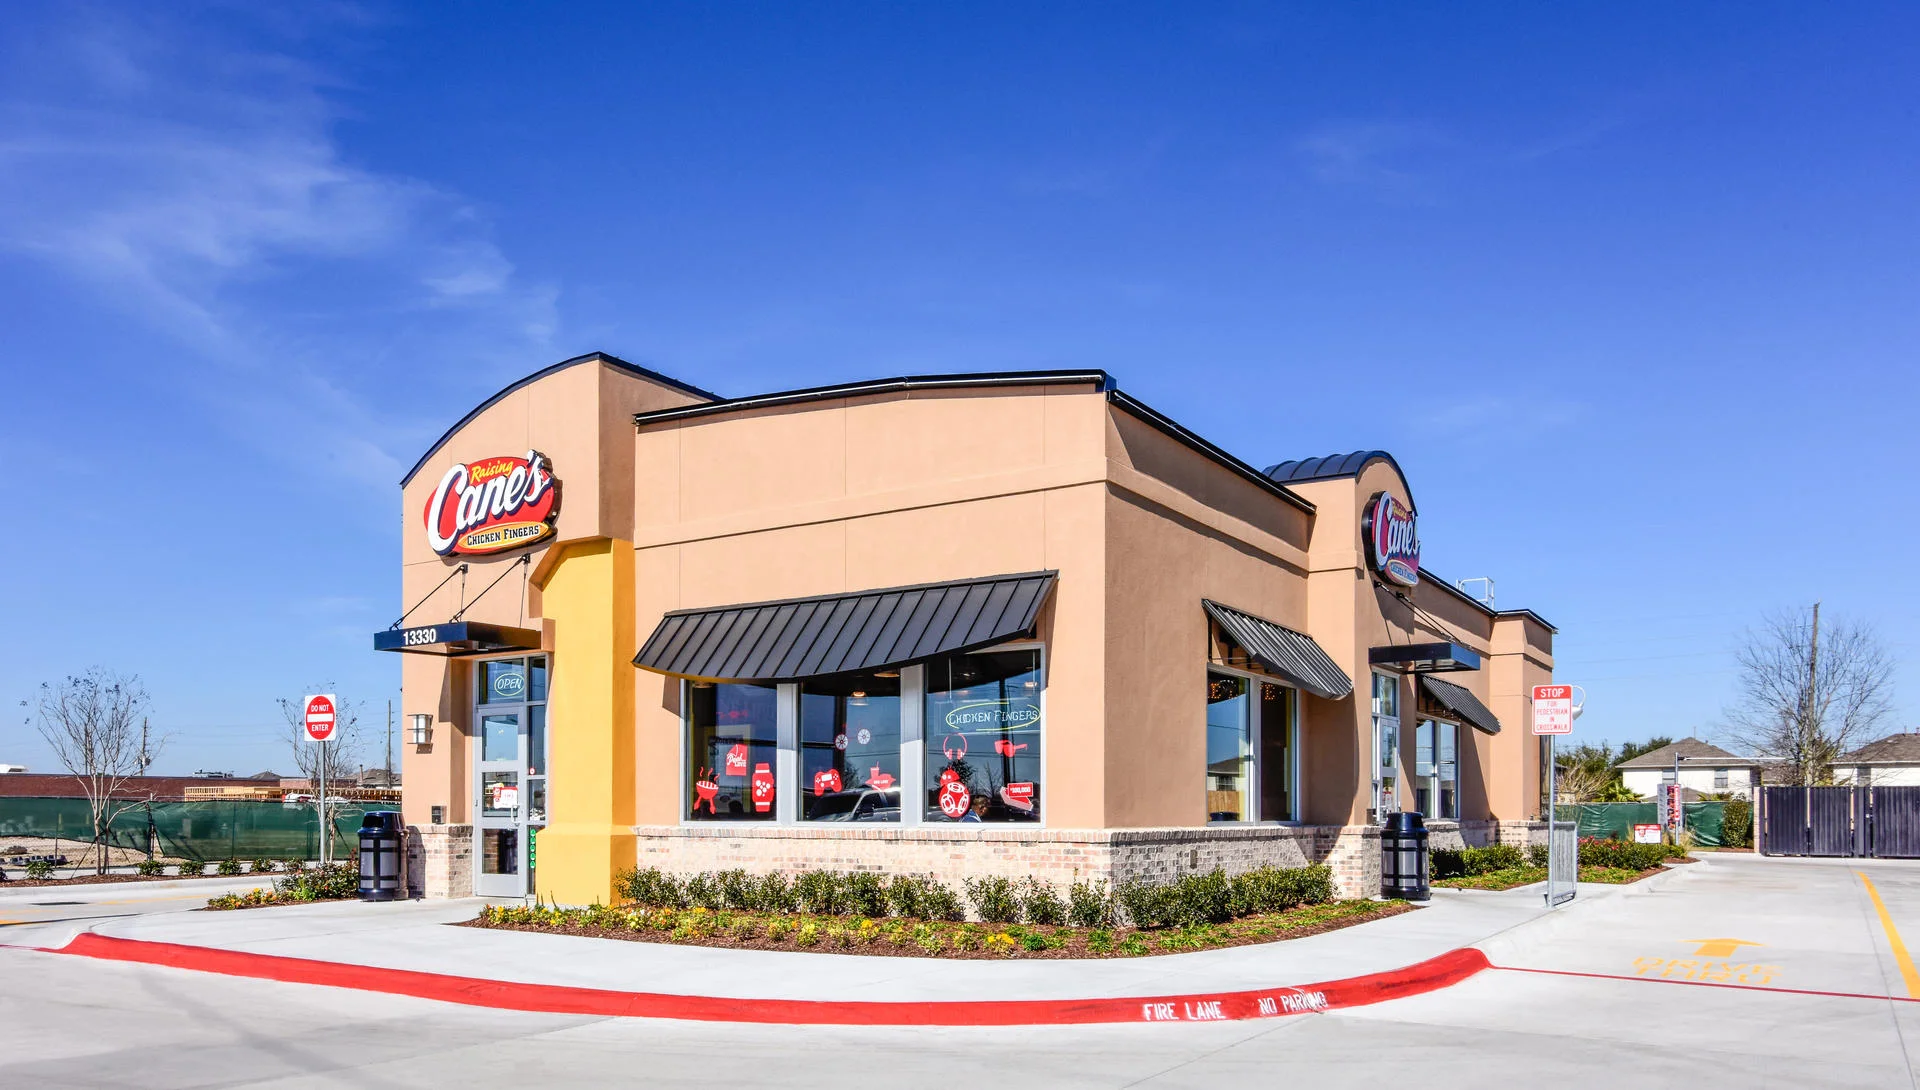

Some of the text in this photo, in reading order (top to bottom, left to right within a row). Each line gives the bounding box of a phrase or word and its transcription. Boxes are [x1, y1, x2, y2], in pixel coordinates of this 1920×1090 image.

[470, 460, 514, 484] Raising
[427, 449, 553, 553] Cane's
[467, 525, 539, 546] CHICKEN FINGERS
[1375, 491, 1420, 567] Cane's
[403, 628, 437, 646] 13330
[497, 678, 522, 690] OPEN
[1540, 688, 1565, 698] STOP
[311, 704, 319, 712] DO
[949, 710, 1038, 725] CHICKEN FINGERS
[312, 724, 329, 732] ENTER
[1142, 1003, 1179, 1021] FIRE
[1184, 1001, 1226, 1021] LANE
[1257, 997, 1277, 1015] NO
